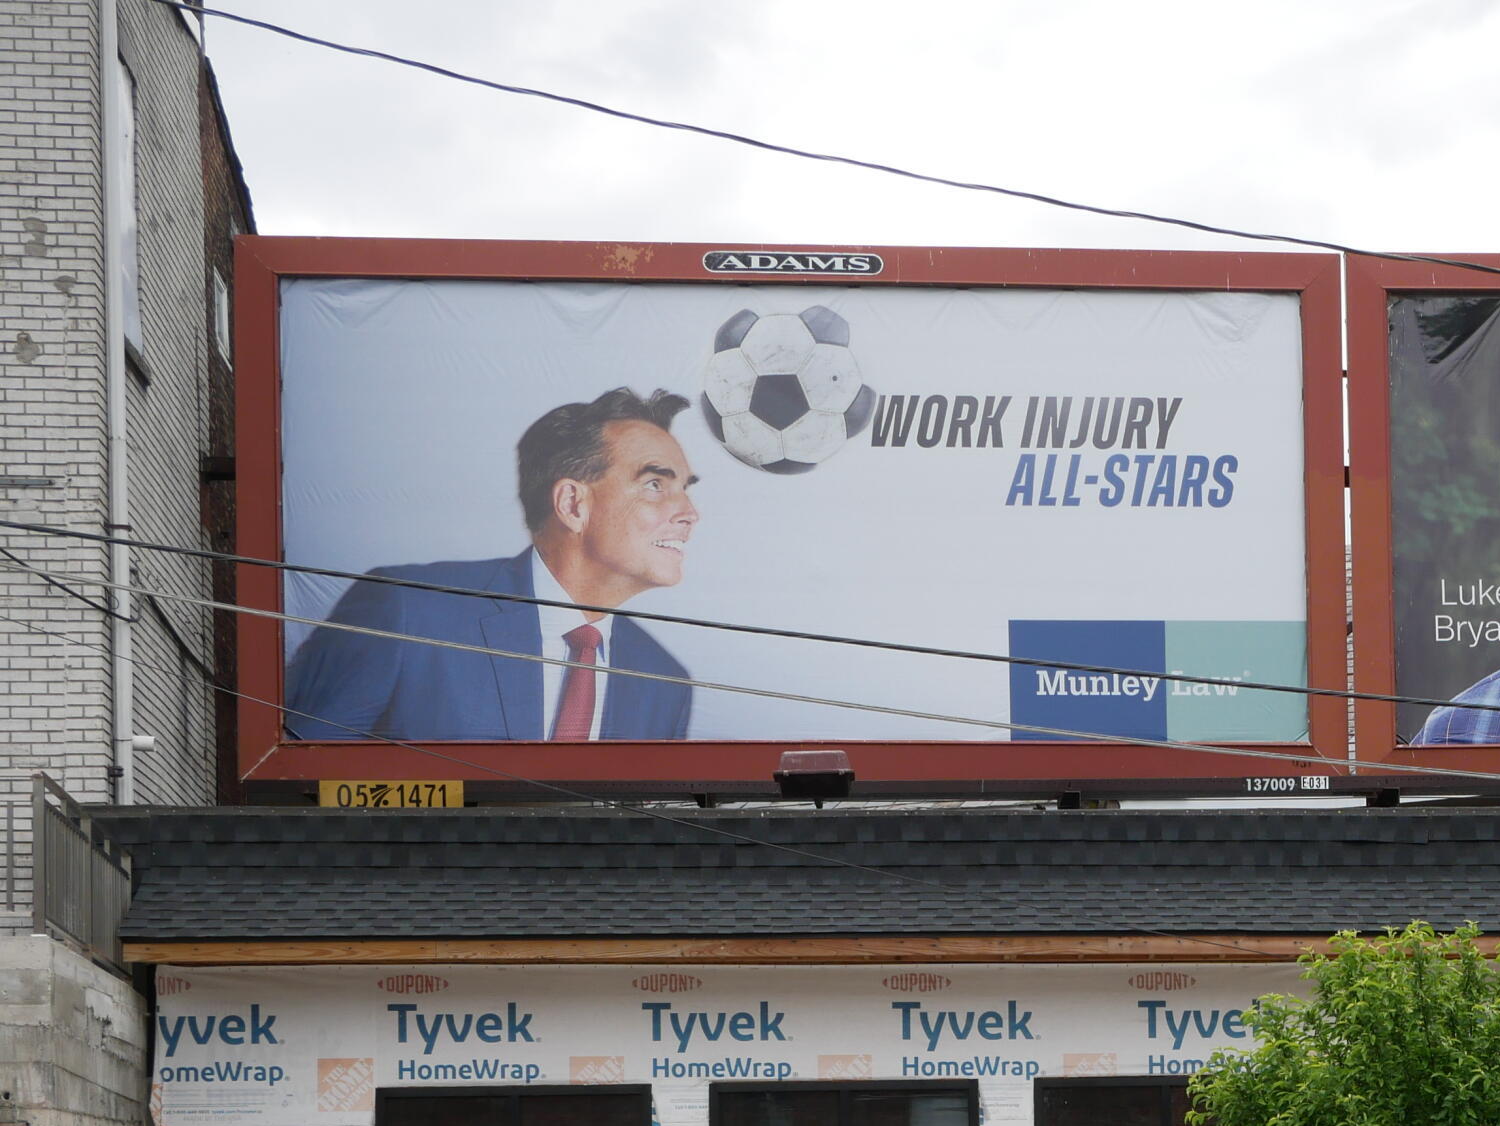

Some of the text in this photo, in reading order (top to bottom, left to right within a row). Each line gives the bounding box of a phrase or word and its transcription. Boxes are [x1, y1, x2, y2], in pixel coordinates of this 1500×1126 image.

[718, 253, 872, 273] ADAMS
[871, 394, 1183, 449] WORK INJURY
[1005, 454, 1239, 507] ALL-STARS
[1036, 670, 1243, 701] Munley Law
[337, 784, 446, 808] 05 1471
[1245, 778, 1296, 792] 137009
[386, 975, 441, 994] DUPONT
[640, 974, 695, 993] DUPONT
[891, 973, 945, 993] DUPONT
[1137, 972, 1189, 991] DUPONT
[158, 1003, 279, 1058] yvek
[387, 1002, 535, 1055] Tyvek
[641, 1001, 786, 1053] Tyvek
[891, 1000, 1034, 1051] Tyvek
[159, 1061, 284, 1086] omeWrap
[398, 1059, 541, 1083] HomeWrap
[652, 1057, 792, 1081] HomeWrap
[902, 1055, 1040, 1080] HomeWrap
